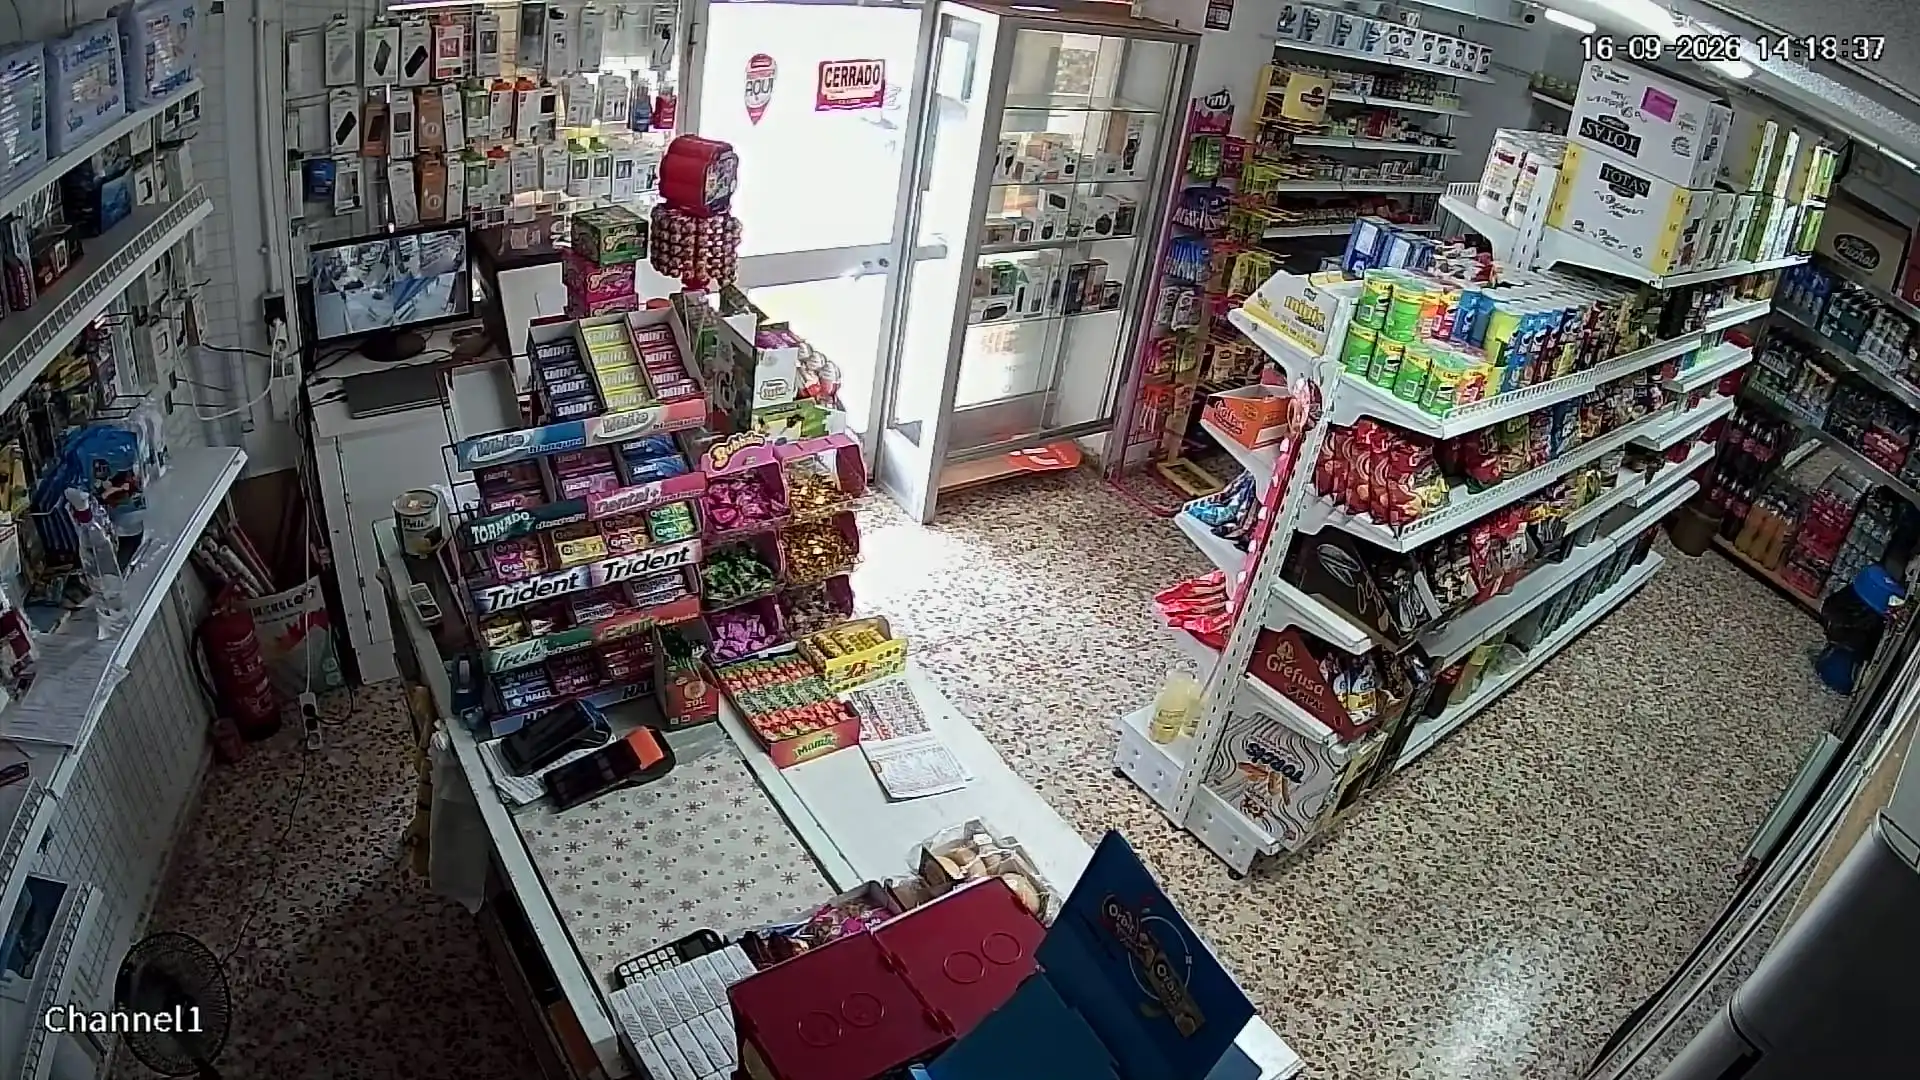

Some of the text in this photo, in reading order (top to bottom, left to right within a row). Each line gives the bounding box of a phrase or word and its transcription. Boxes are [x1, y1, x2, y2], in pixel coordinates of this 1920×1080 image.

[824, 64, 880, 88] CERRADO
[1580, 120, 1641, 155] TOTAS
[1602, 165, 1650, 194] TOTAS
[471, 511, 531, 545] TORNADO
[602, 546, 692, 583] Trident
[486, 572, 580, 612] Trident
[1266, 653, 1325, 697] Grefusa
